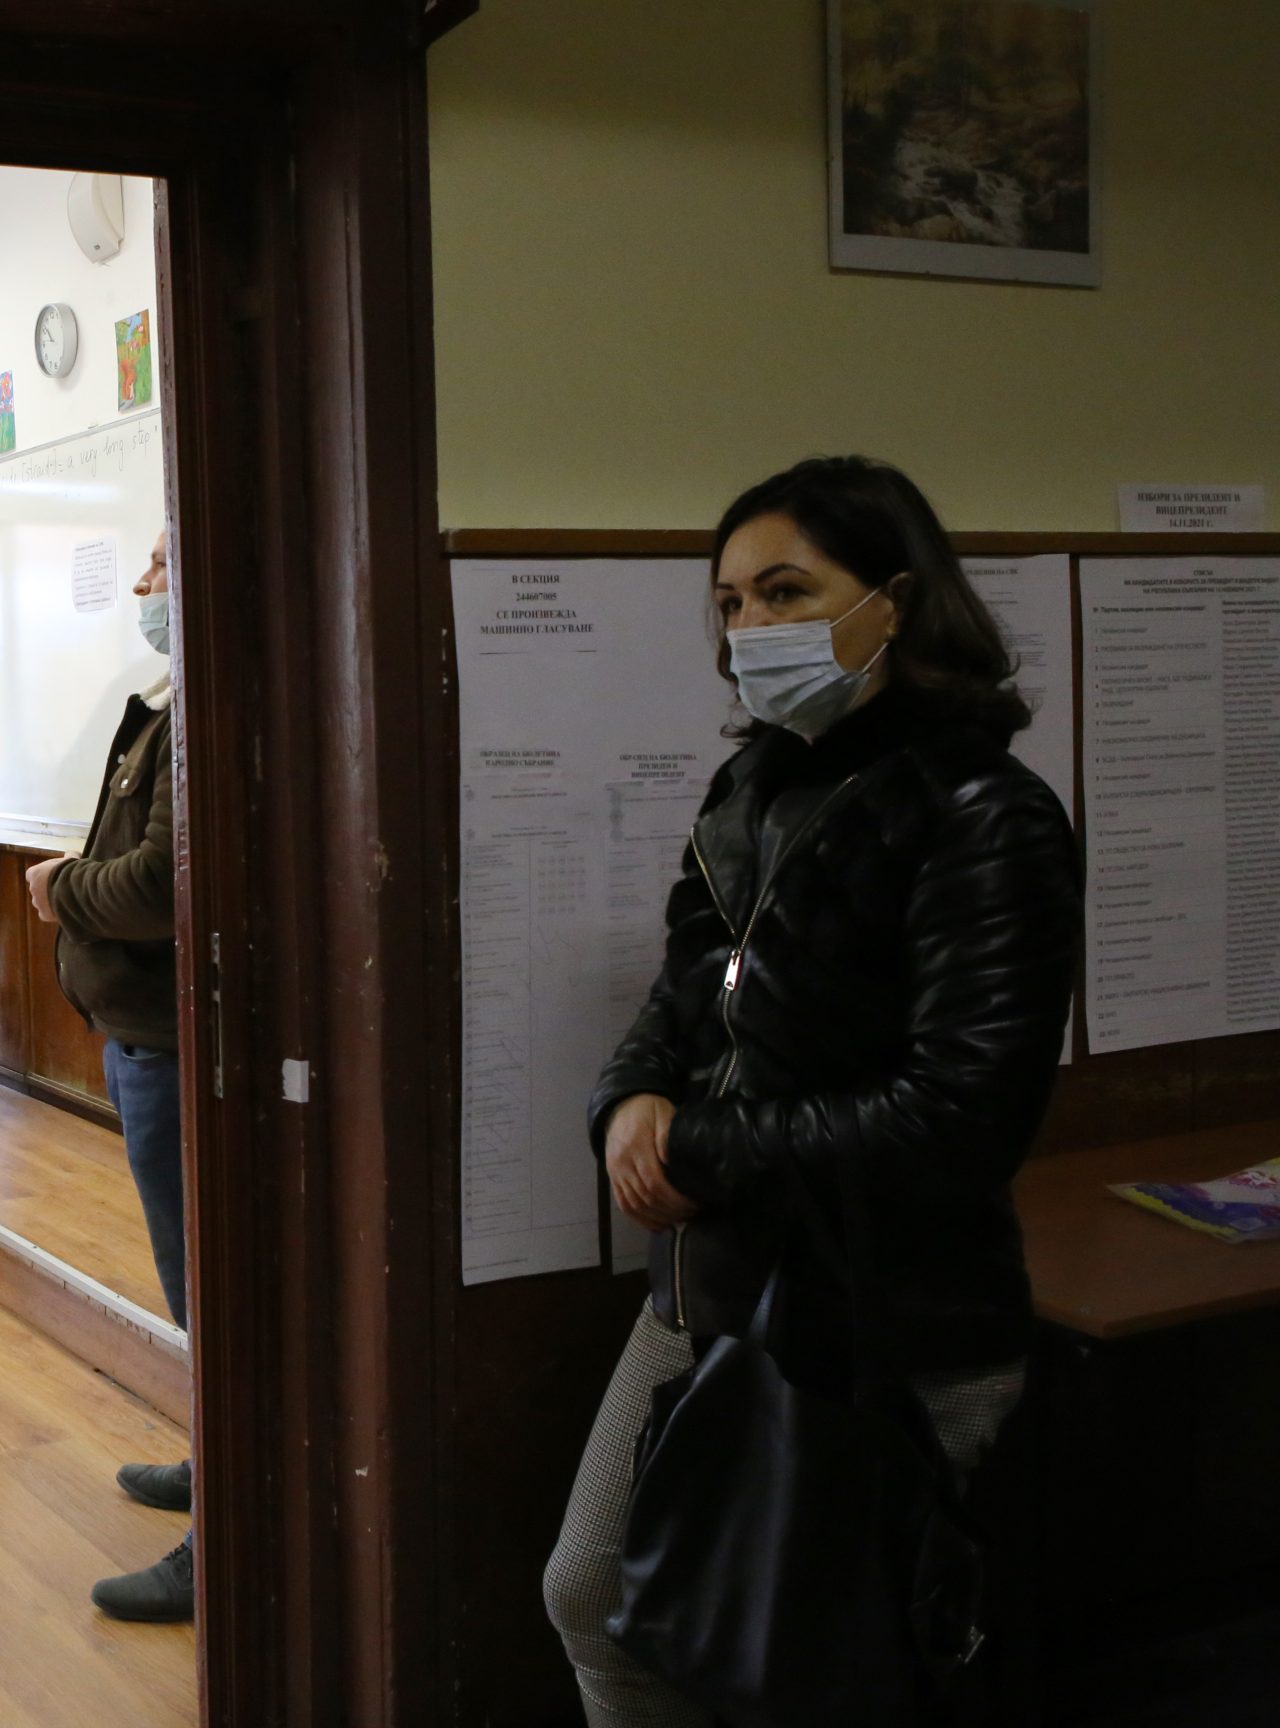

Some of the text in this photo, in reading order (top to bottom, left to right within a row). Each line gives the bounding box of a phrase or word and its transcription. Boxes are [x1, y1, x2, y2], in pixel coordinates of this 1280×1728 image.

[511, 574, 560, 585] В СЕКЦИЯ
[495, 610, 510, 620] СЕ
[480, 623, 595, 636] МАШИННО ГЛАСУВАНЕ
